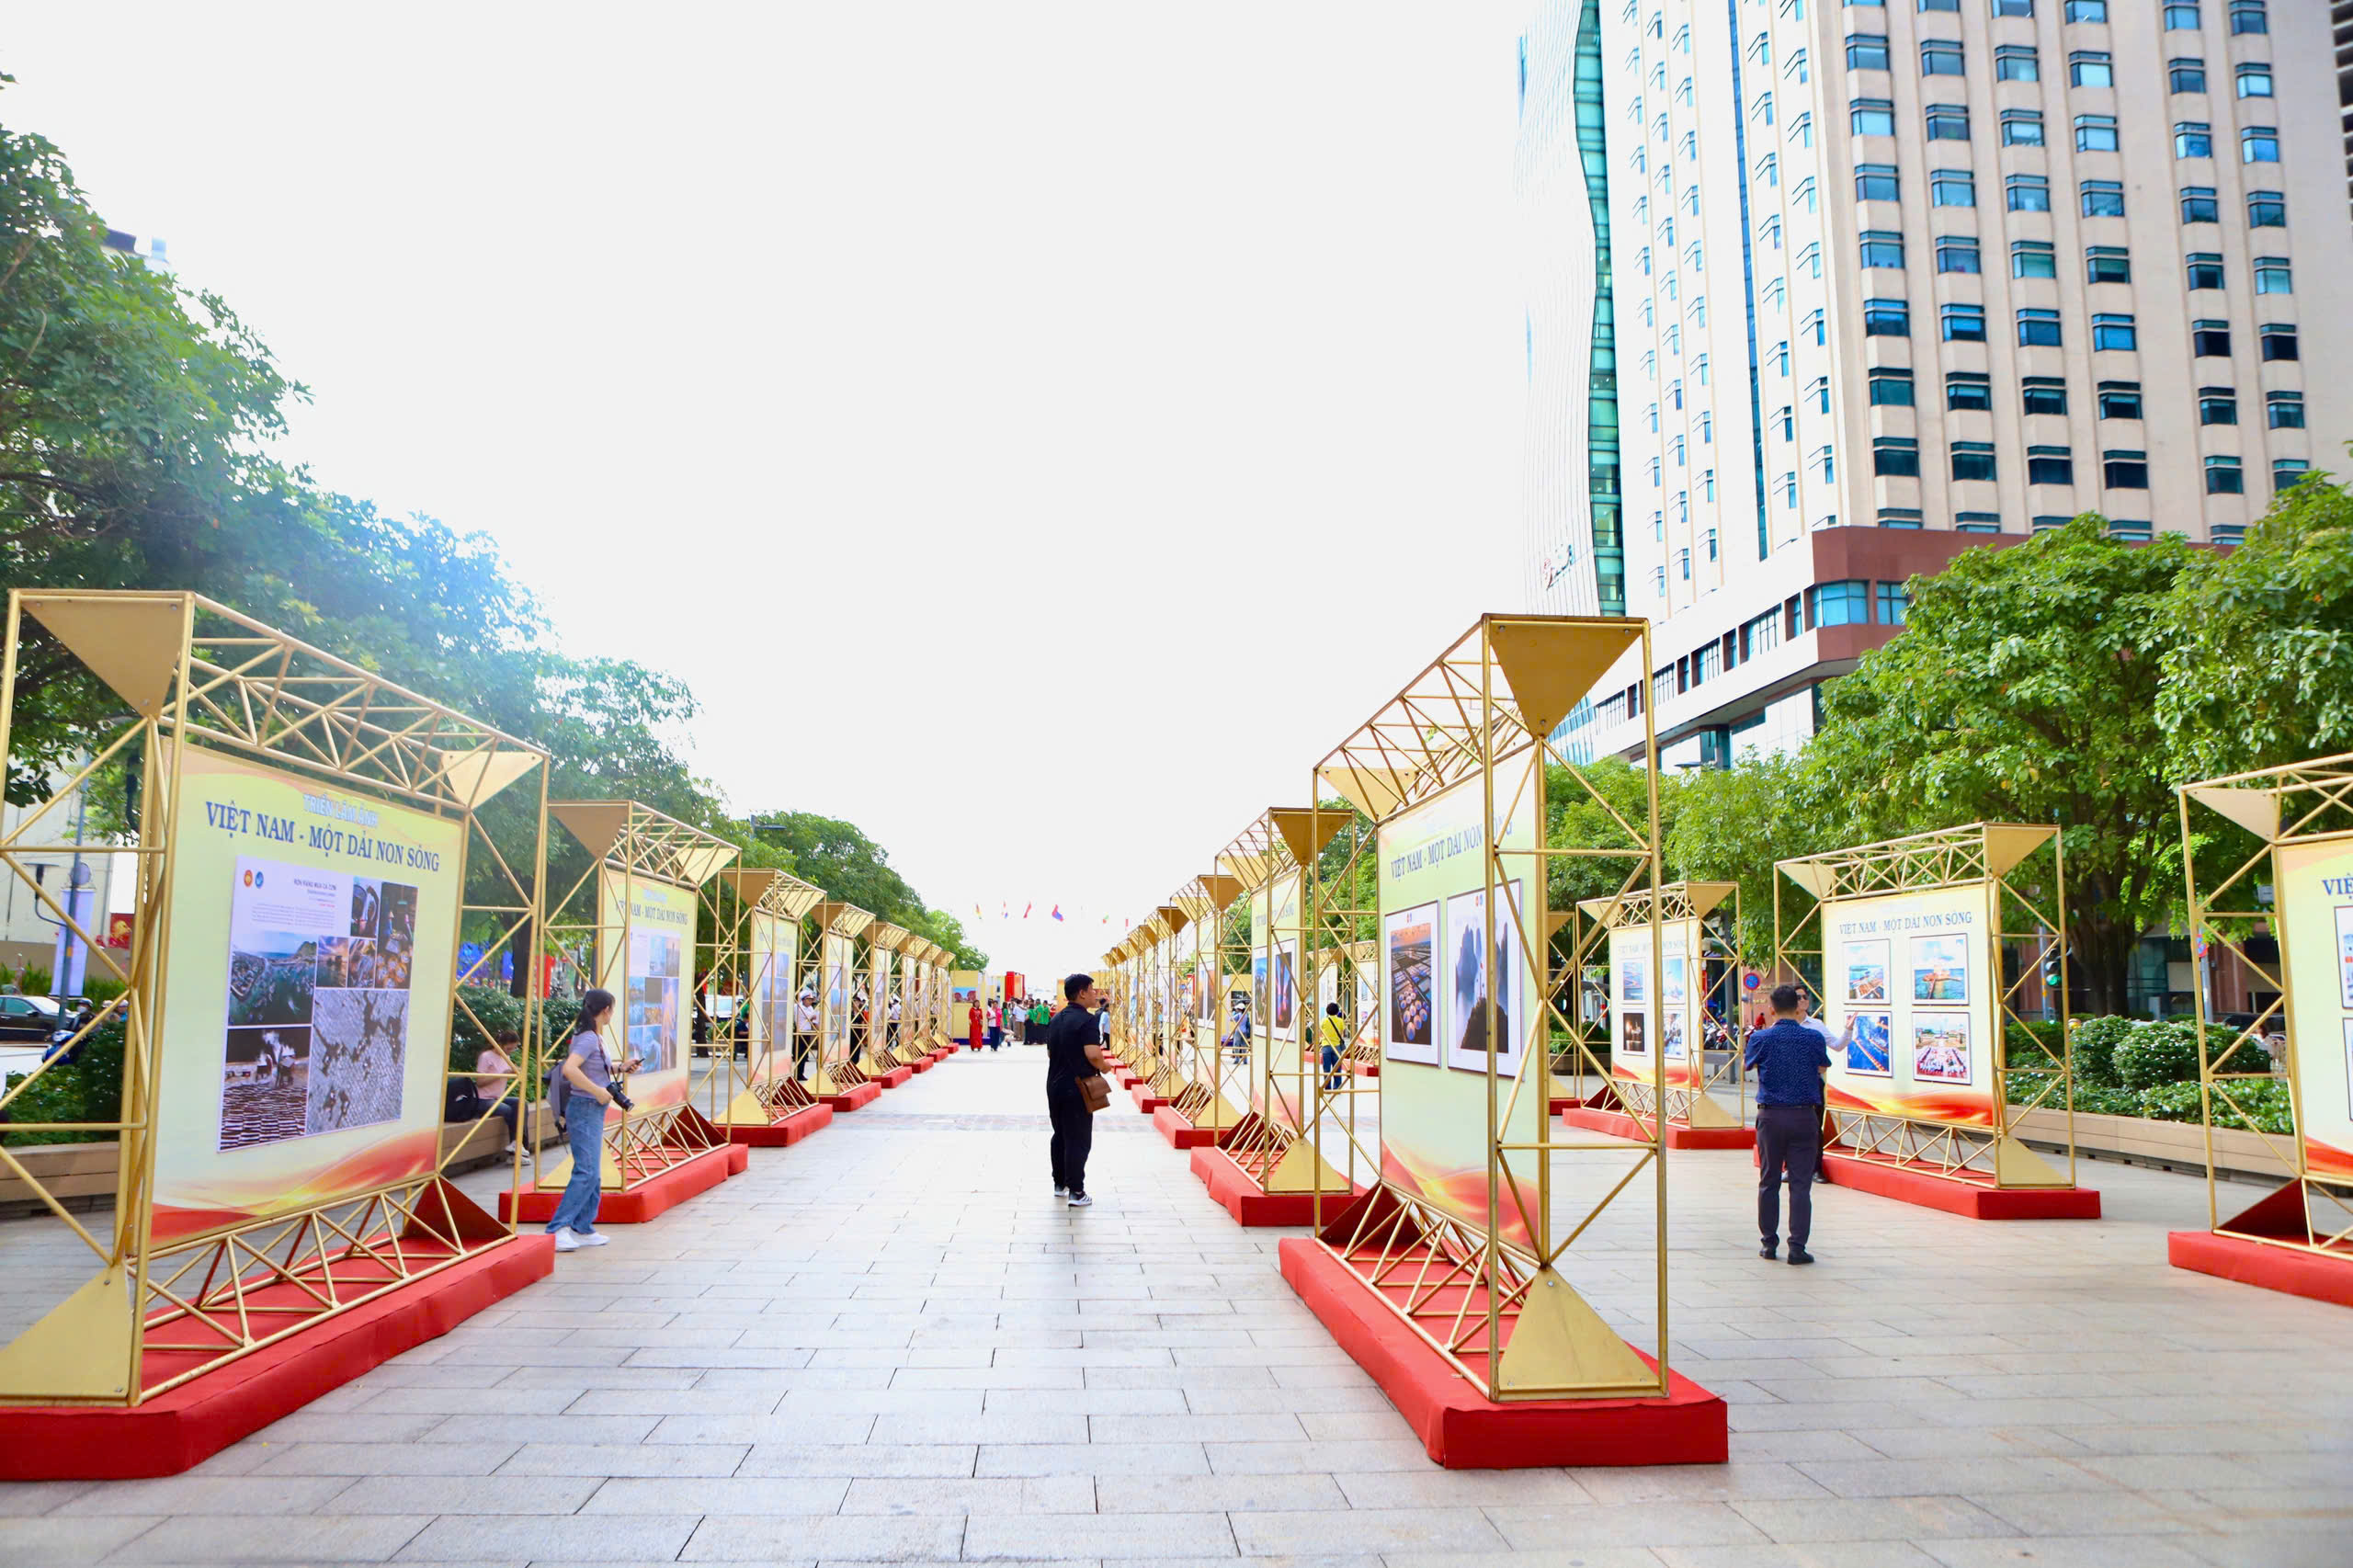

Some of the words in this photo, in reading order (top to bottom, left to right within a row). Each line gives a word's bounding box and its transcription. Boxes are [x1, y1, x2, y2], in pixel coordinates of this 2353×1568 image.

[206, 800, 251, 838] VIỆT
[256, 813, 295, 843] NAM
[309, 824, 344, 858] MỘT
[347, 830, 372, 859] DẢI
[376, 840, 404, 865] NON
[407, 844, 439, 871] SÔNG
[1407, 849, 1422, 873] NAM
